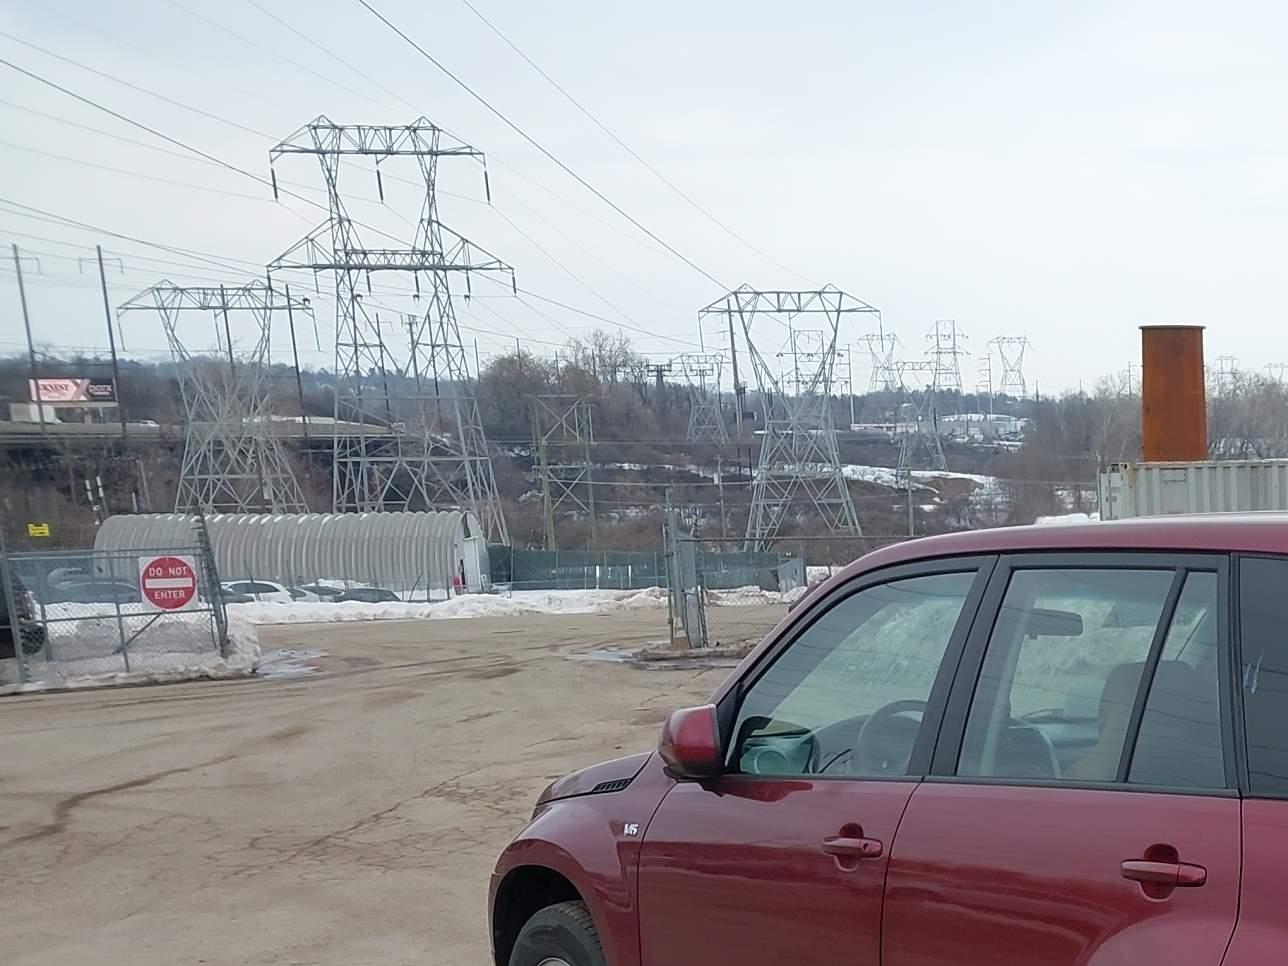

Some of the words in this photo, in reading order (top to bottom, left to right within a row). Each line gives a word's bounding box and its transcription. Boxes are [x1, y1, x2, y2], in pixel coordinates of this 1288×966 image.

[148, 567, 163, 576] DO
[168, 566, 188, 576] NOT
[154, 590, 185, 600] ENTER
